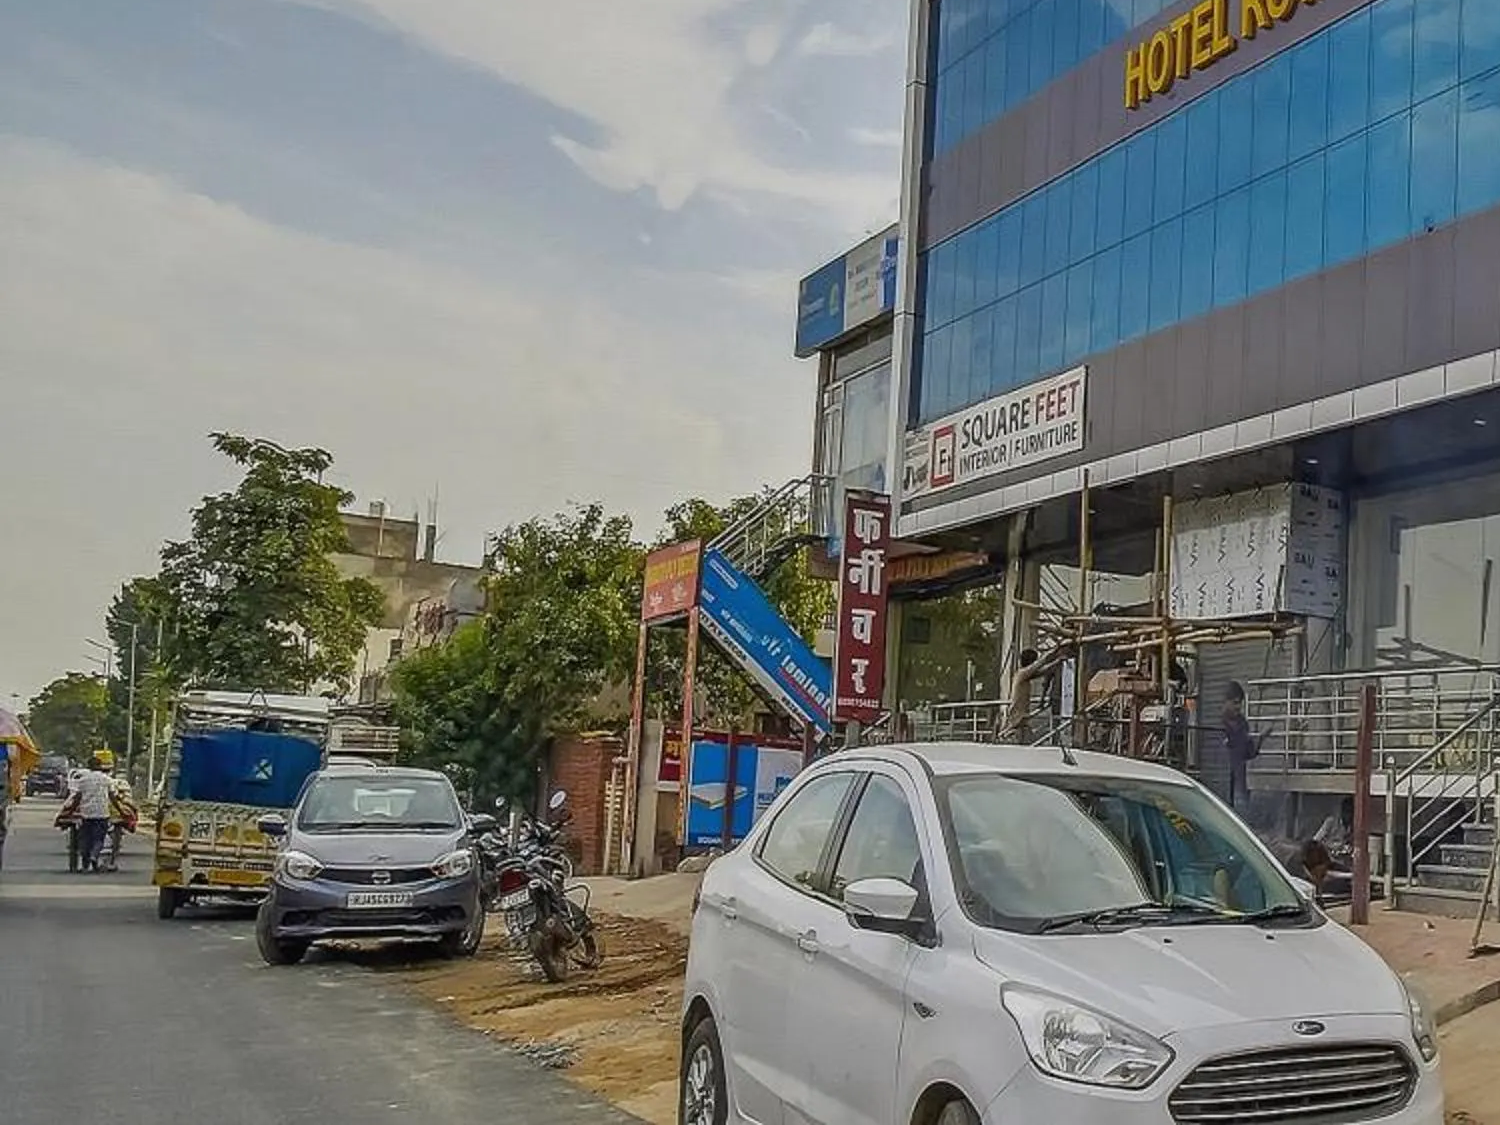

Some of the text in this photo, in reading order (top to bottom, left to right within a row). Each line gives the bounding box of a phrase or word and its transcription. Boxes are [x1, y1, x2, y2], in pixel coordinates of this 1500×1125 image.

[960, 379, 1081, 449] SQUARE FEET
[959, 420, 1079, 476] INTERIOR FURNITURE
